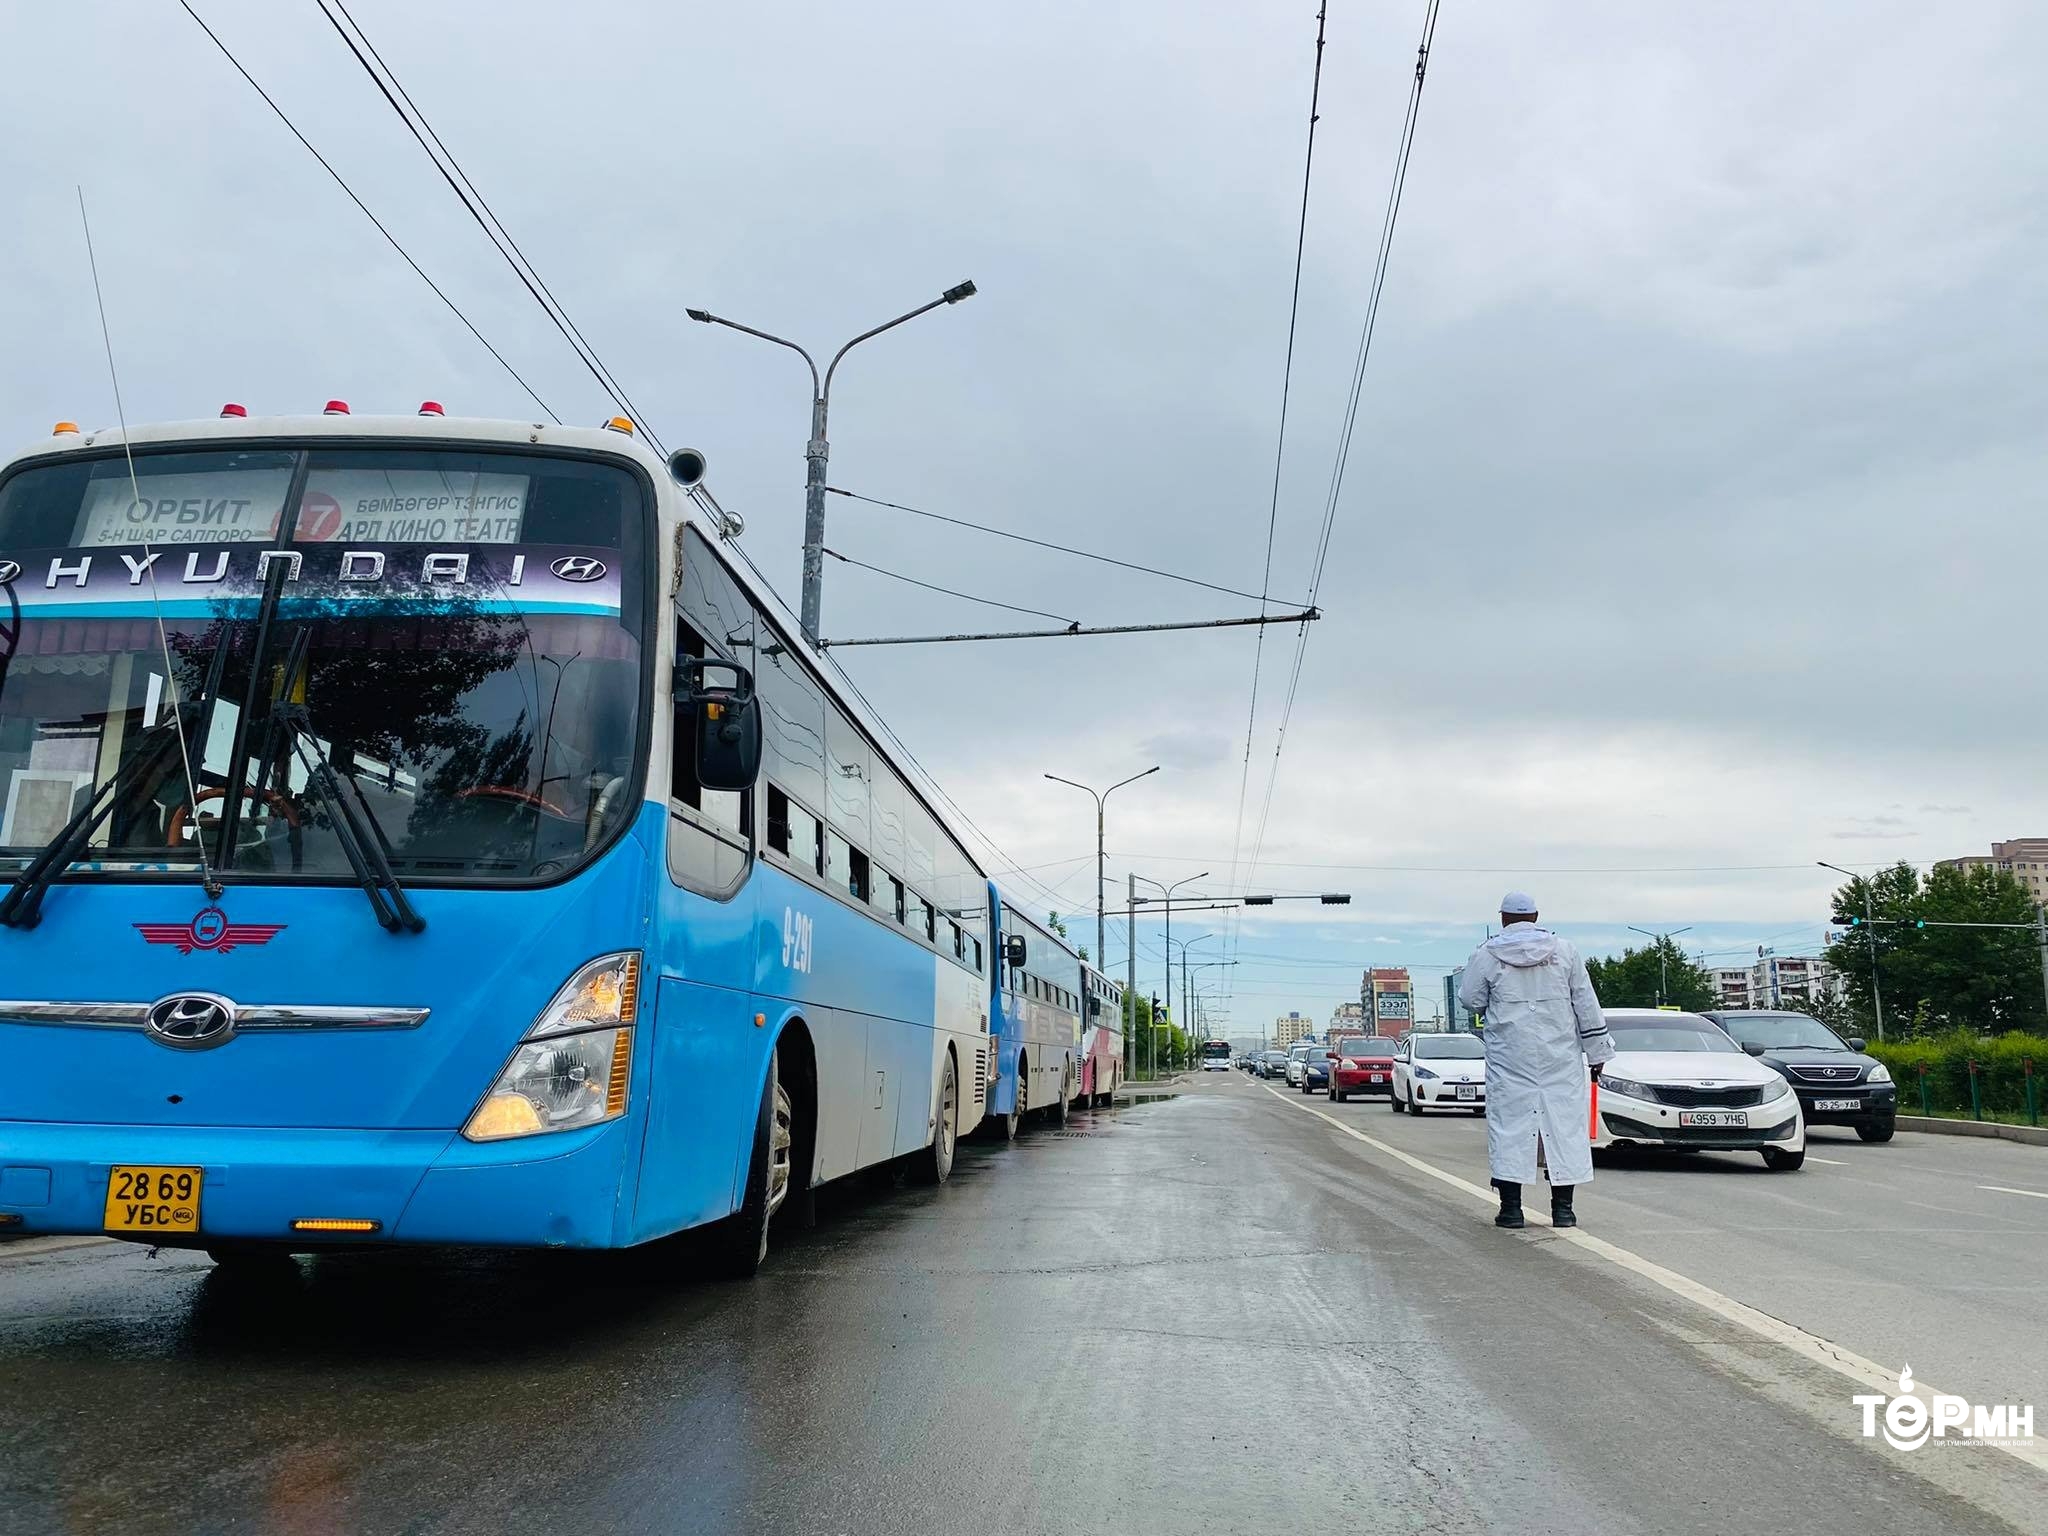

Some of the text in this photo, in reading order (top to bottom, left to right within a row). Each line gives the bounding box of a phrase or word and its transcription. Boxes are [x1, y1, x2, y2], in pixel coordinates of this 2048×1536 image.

[126, 498, 252, 525] ОРБИТ
[356, 496, 520, 514] БӨМБӨГӨР ТЭНГИС
[98, 527, 252, 543] 5-Н ШАР САППОРО
[336, 517, 520, 542] АРД КИНО ТЕАТР
[46, 551, 526, 588] HYUNDAI
[782, 906, 813, 975] 9-291
[1380, 1001, 1407, 1009] ЗЭЭЛ
[1689, 1113, 1717, 1125] 4959
[115, 1172, 193, 1200] 28 69
[123, 1204, 171, 1225] УБС
